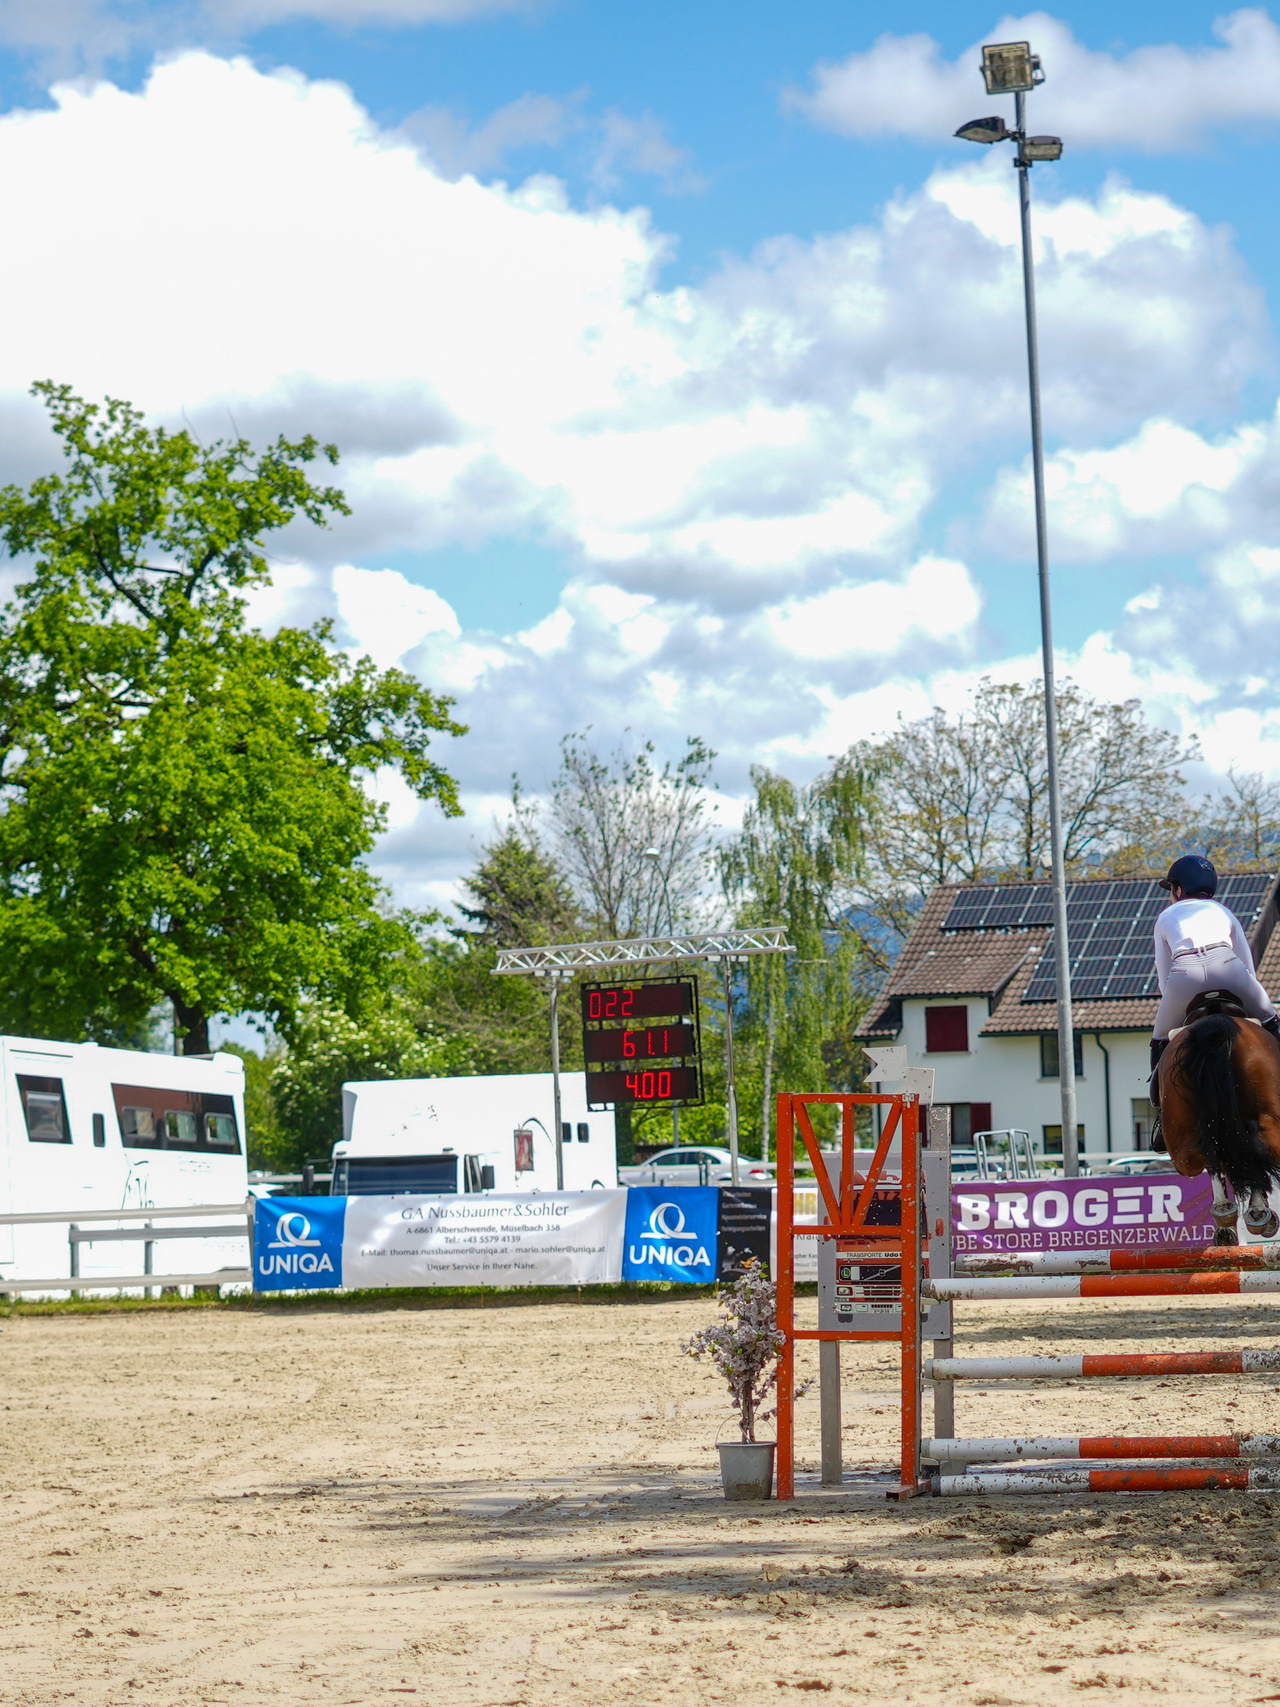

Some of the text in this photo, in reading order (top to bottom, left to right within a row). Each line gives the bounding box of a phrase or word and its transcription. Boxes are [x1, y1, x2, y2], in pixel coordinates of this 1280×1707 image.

[589, 990, 634, 1018] 022
[623, 1030, 668, 1057] 61.1
[626, 1071, 671, 1099] 4.00
[401, 1207, 424, 1220] GA
[957, 1185, 1184, 1231] BROGER
[480, 1235, 499, 1243] 5579
[501, 1235, 521, 1243] 4139
[982, 1232, 1043, 1249] STORE
[1048, 1225, 1216, 1247] BREGENZERWALD
[259, 1253, 334, 1275] UNIQA
[452, 1263, 481, 1271] Service
[492, 1262, 512, 1270] Ihrer
[629, 1245, 711, 1266] UNIQA
